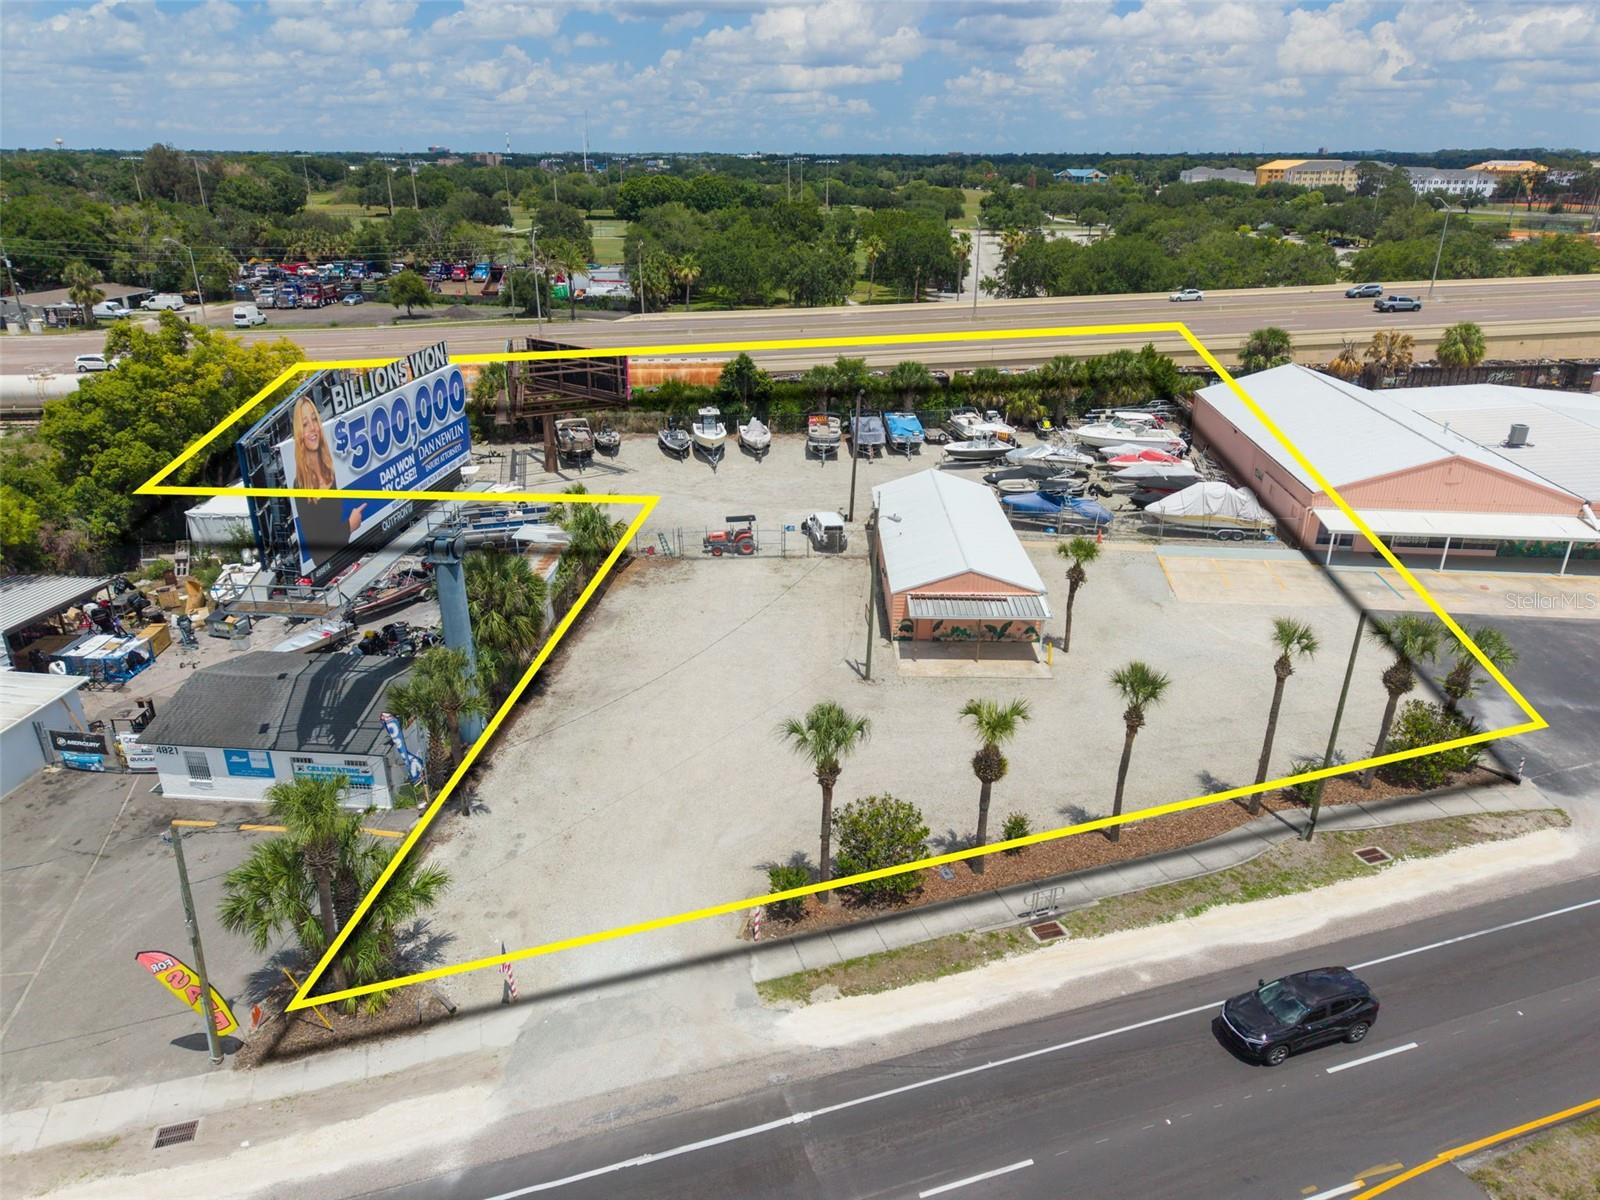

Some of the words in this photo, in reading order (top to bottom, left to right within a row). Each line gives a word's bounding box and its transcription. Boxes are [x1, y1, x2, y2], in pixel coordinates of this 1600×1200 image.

[331, 356, 409, 415] BILLIONS
[411, 340, 448, 377] WON!
[334, 368, 466, 470] $500,000
[418, 440, 435, 460] DAN
[435, 422, 464, 450] NEWLIN
[379, 465, 397, 485] DAN
[396, 453, 416, 474] WON
[66, 740, 101, 748] MERCURY
